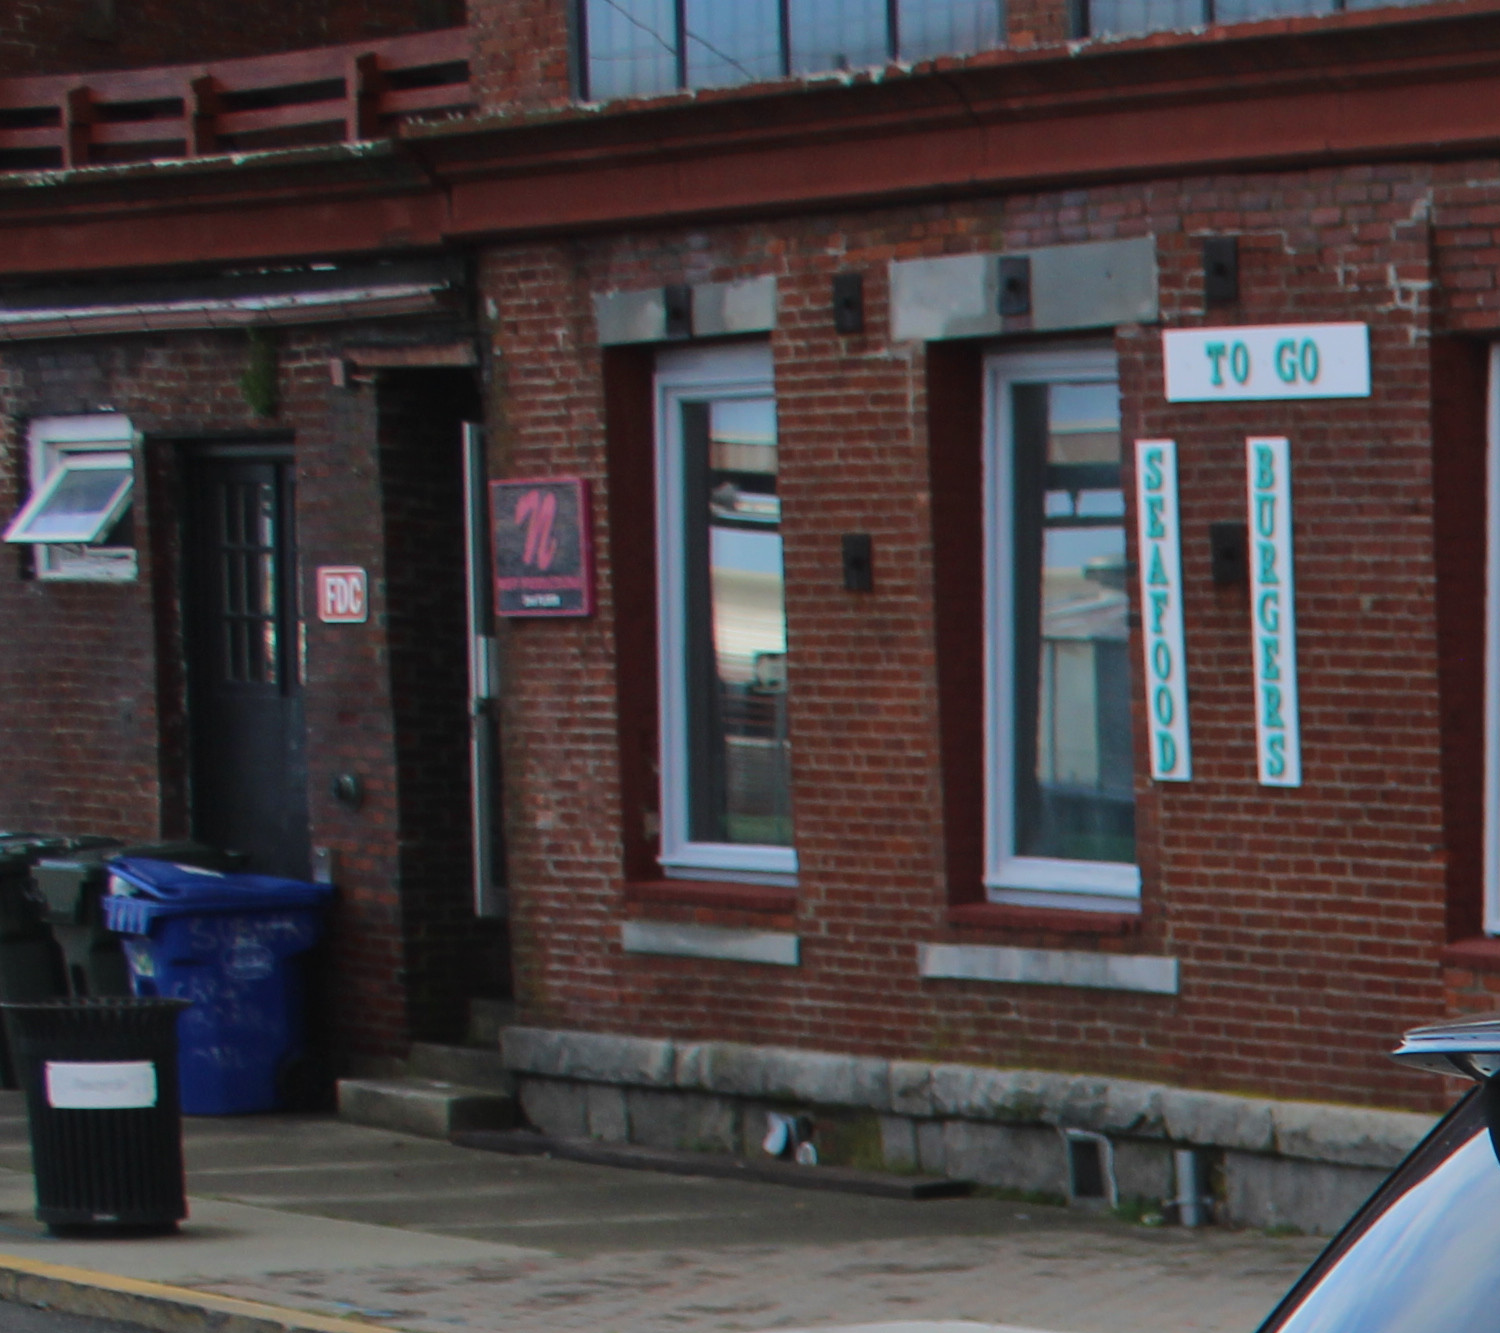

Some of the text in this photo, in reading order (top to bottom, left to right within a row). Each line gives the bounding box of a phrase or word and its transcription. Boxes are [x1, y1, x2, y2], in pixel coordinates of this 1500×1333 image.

[1204, 337, 1321, 388] TO GO
[325, 576, 362, 614] FDC
[1144, 449, 1176, 776] SEAFOOD
[1255, 443, 1288, 777] BURGERS
